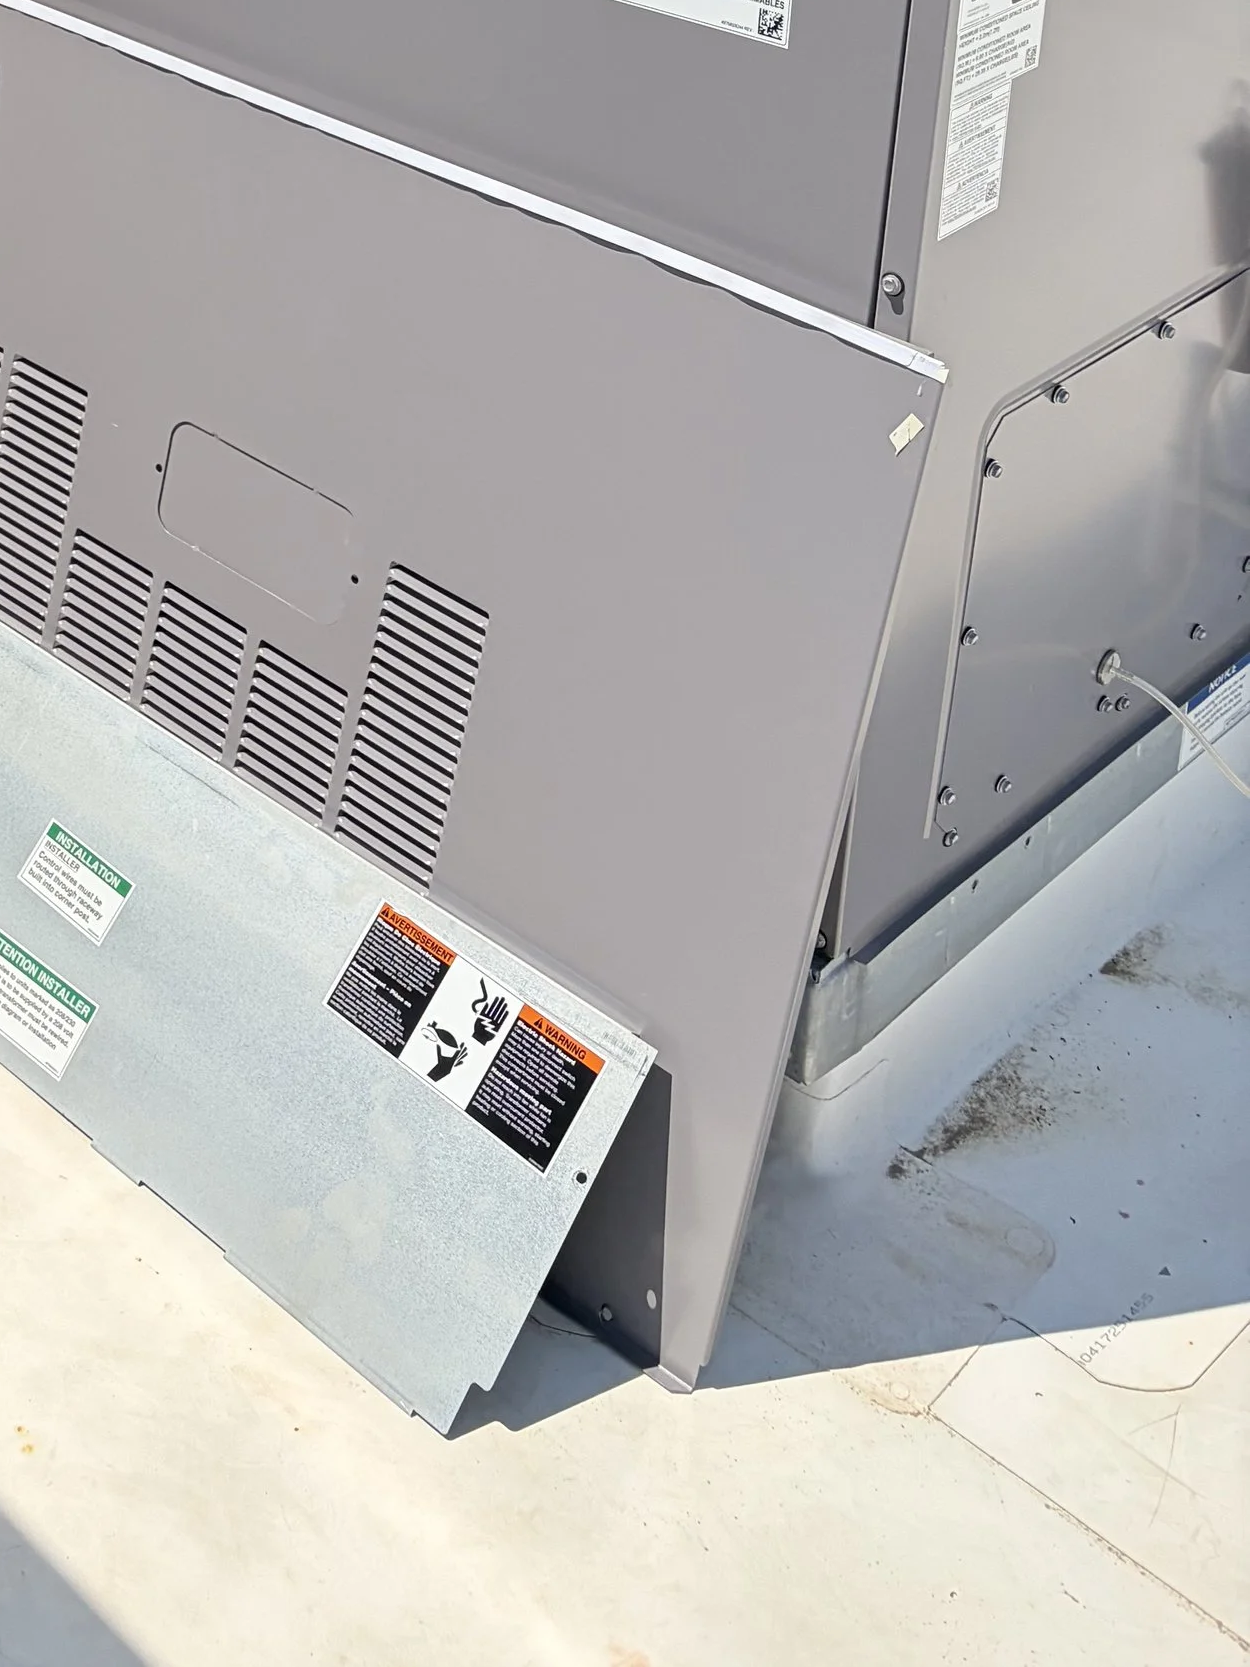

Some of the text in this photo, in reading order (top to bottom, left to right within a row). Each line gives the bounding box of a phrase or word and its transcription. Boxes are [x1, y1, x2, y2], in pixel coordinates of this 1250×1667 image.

[1208, 665, 1237, 693] NOTICE
[44, 839, 80, 872] INSTALLER
[54, 830, 121, 889] INSTALLATION
[28, 867, 91, 924] built into corner post.
[32, 858, 102, 921] routed through raceway
[37, 849, 104, 907] Control wires must be
[389, 911, 453, 964] AVERTISSEMENT
[9, 972, 16, 981] to
[15, 976, 30, 991] units
[28, 987, 49, 1006] marked
[47, 1003, 55, 1011] as
[35, 969, 92, 1019] INSTALLER
[0, 1002, 22, 1023] diagram
[21, 1019, 28, 1027] or
[27, 1011, 41, 1025] must
[40, 1021, 48, 1031] be
[543, 1024, 587, 1061] WARNING
